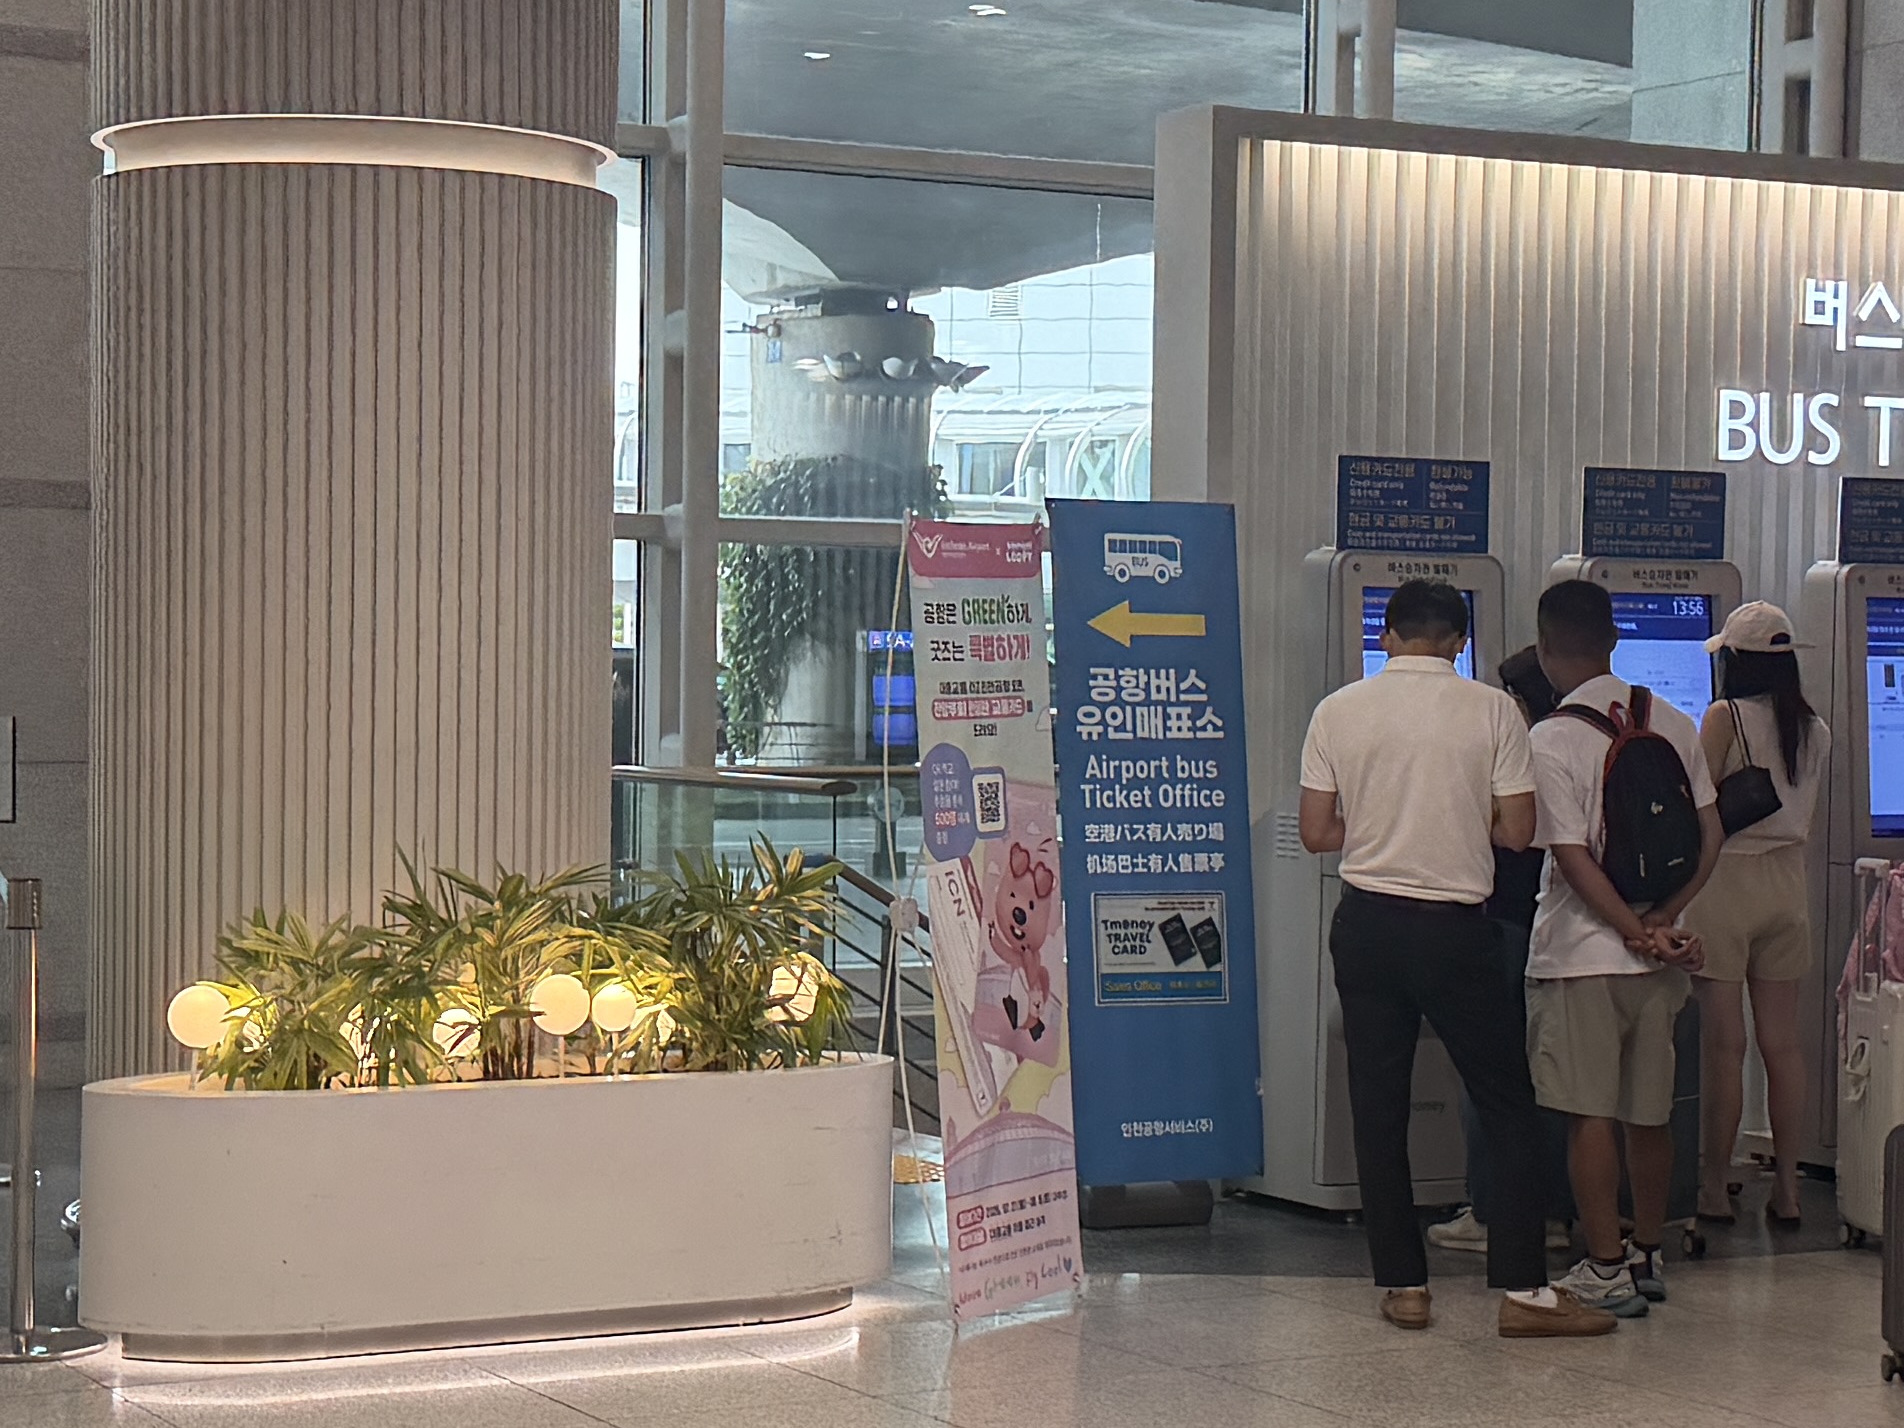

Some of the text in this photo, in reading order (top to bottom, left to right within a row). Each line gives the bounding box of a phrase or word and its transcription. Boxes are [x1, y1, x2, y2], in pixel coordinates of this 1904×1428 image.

[1717, 389, 1841, 466] BUS
[923, 602, 957, 625] 공항은
[1673, 601, 1704, 615] 13:56
[930, 634, 1030, 662] 굿즈는 특별하게!
[1088, 667, 1209, 703] 공항버스
[1076, 705, 1224, 741] 유인매표소
[1085, 754, 1218, 785] Airport bus
[1080, 783, 1226, 809] Ticket Office
[945, 871, 966, 917] ICN
[1101, 919, 1155, 933] Tmoney
[1106, 932, 1152, 944] TRAVEL
[1112, 944, 1147, 955] CARD
